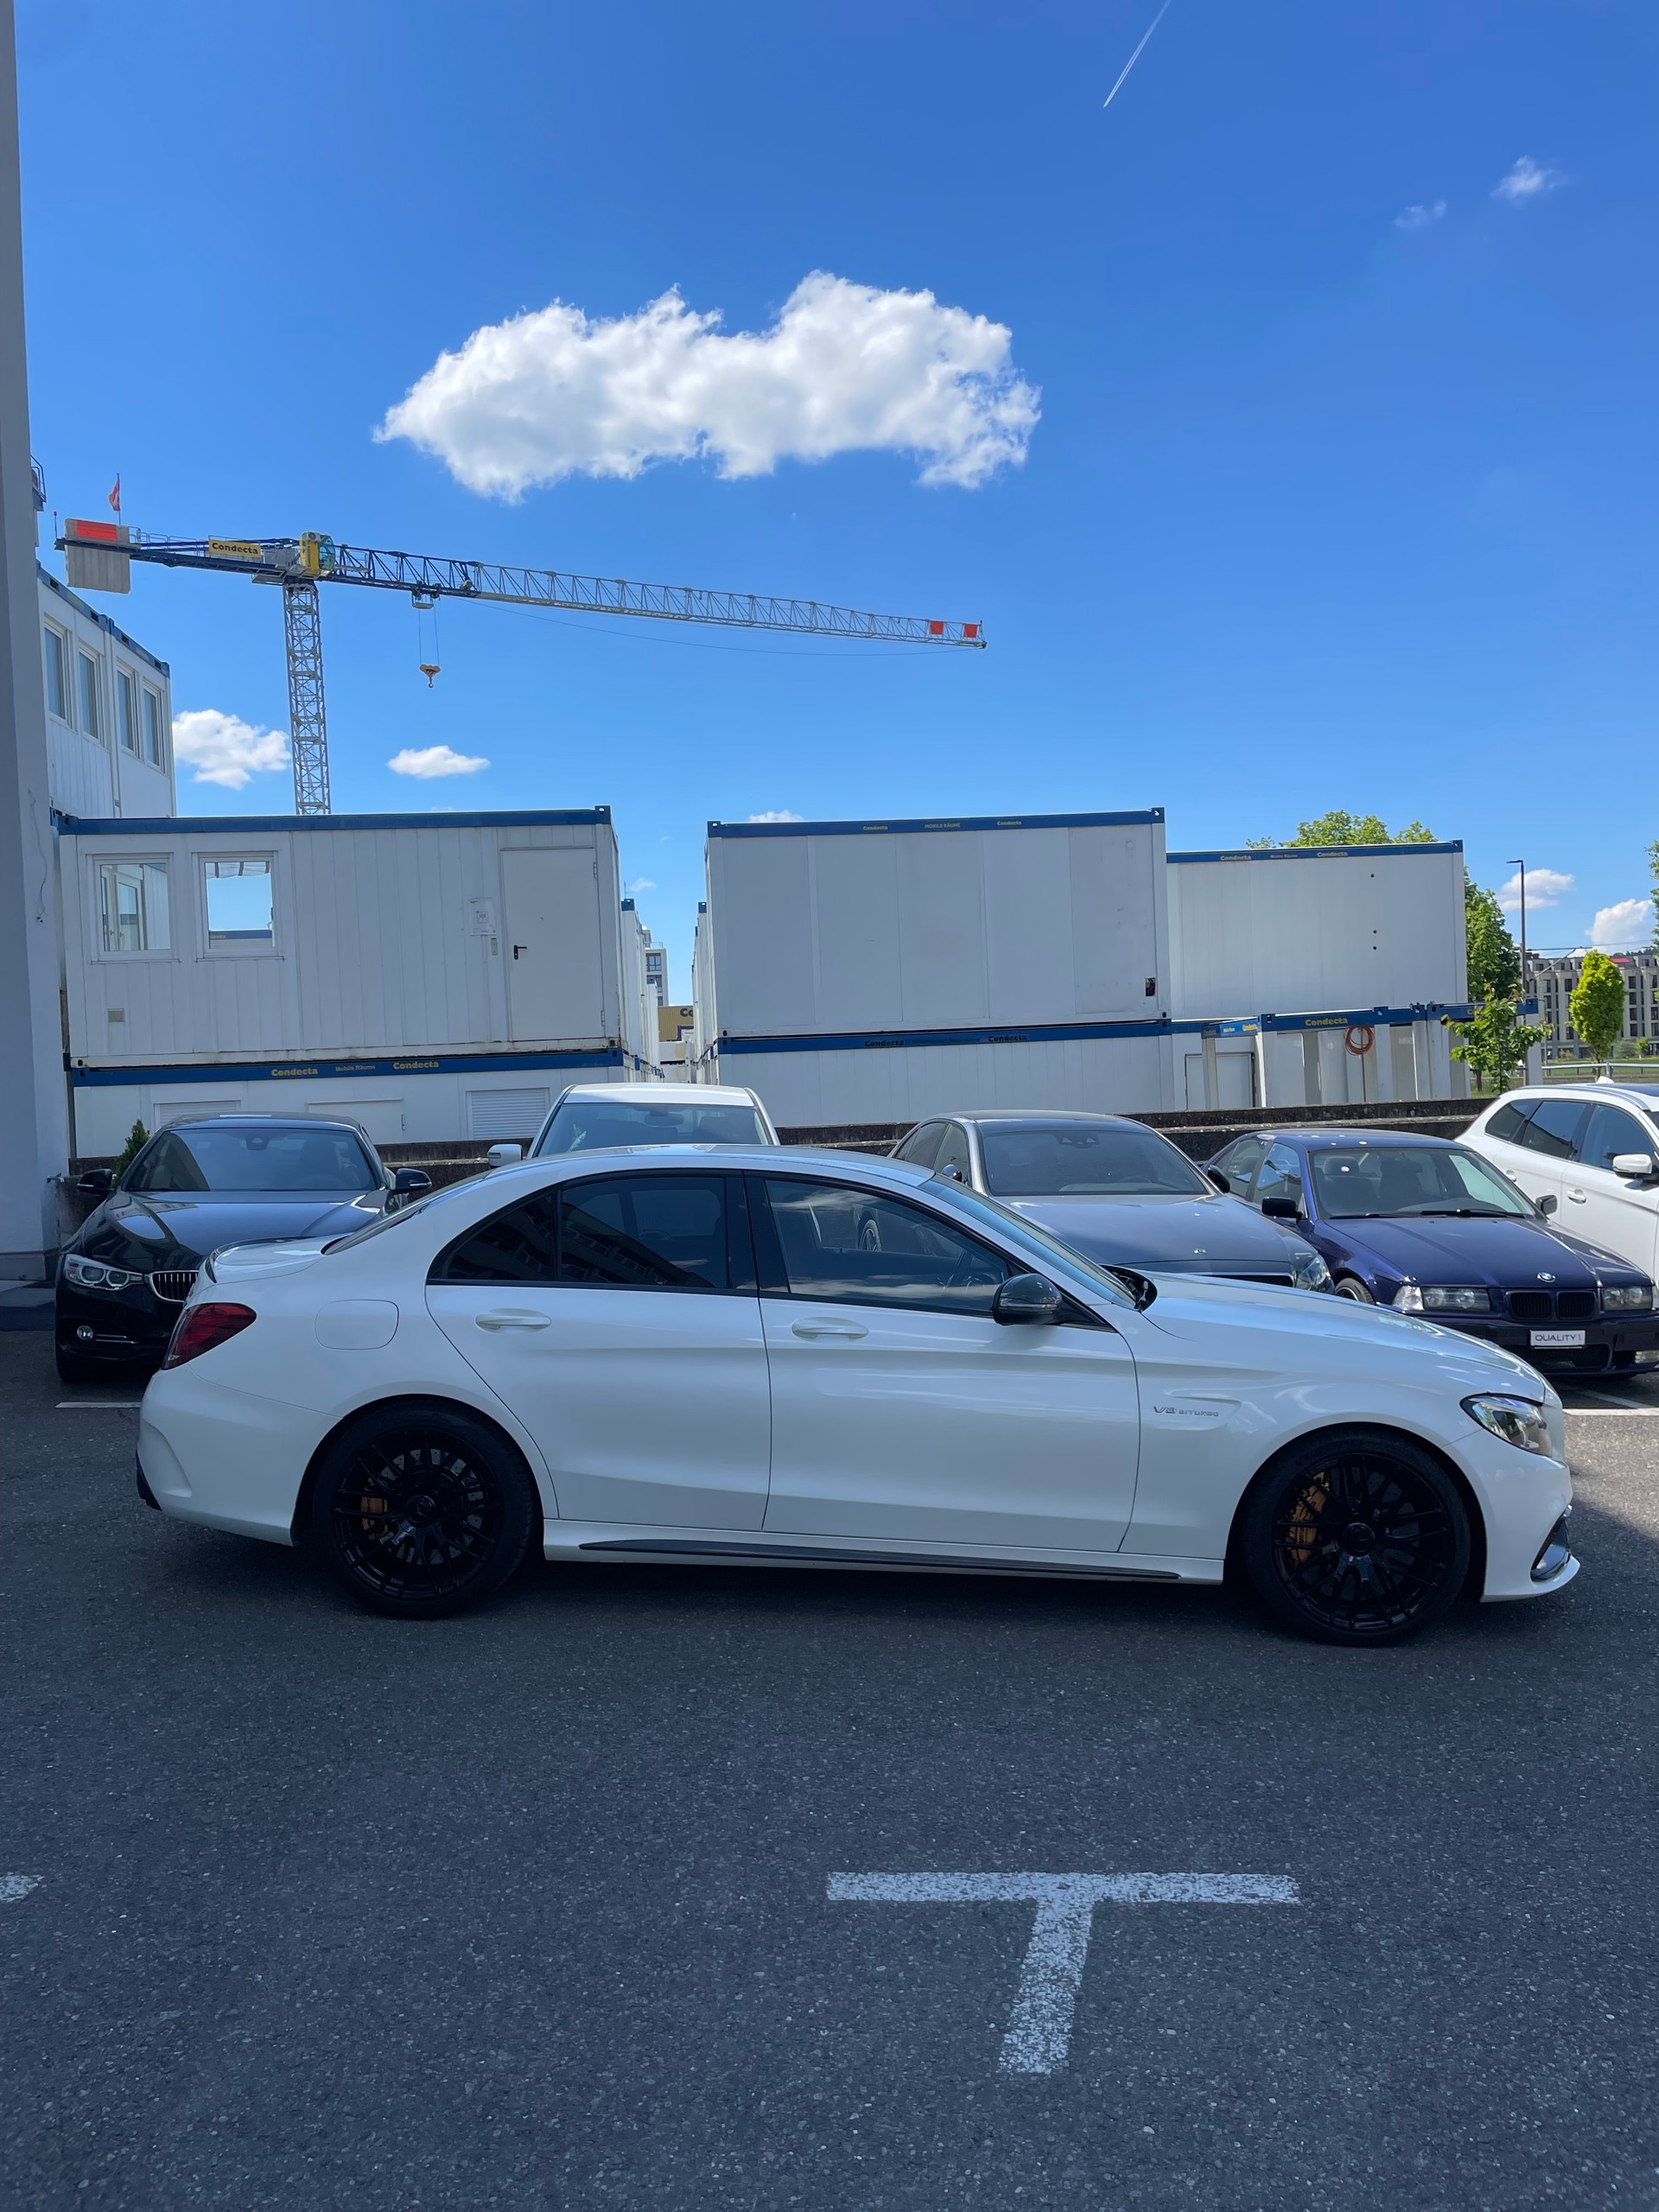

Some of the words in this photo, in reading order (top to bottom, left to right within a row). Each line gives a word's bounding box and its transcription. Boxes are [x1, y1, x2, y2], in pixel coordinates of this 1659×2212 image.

[212, 543, 258, 555] Condecta
[1305, 1017, 1348, 1027] Condecta
[271, 1067, 318, 1077] Condecta
[393, 1060, 440, 1070] Condecta
[1154, 1406, 1176, 1414] V8
